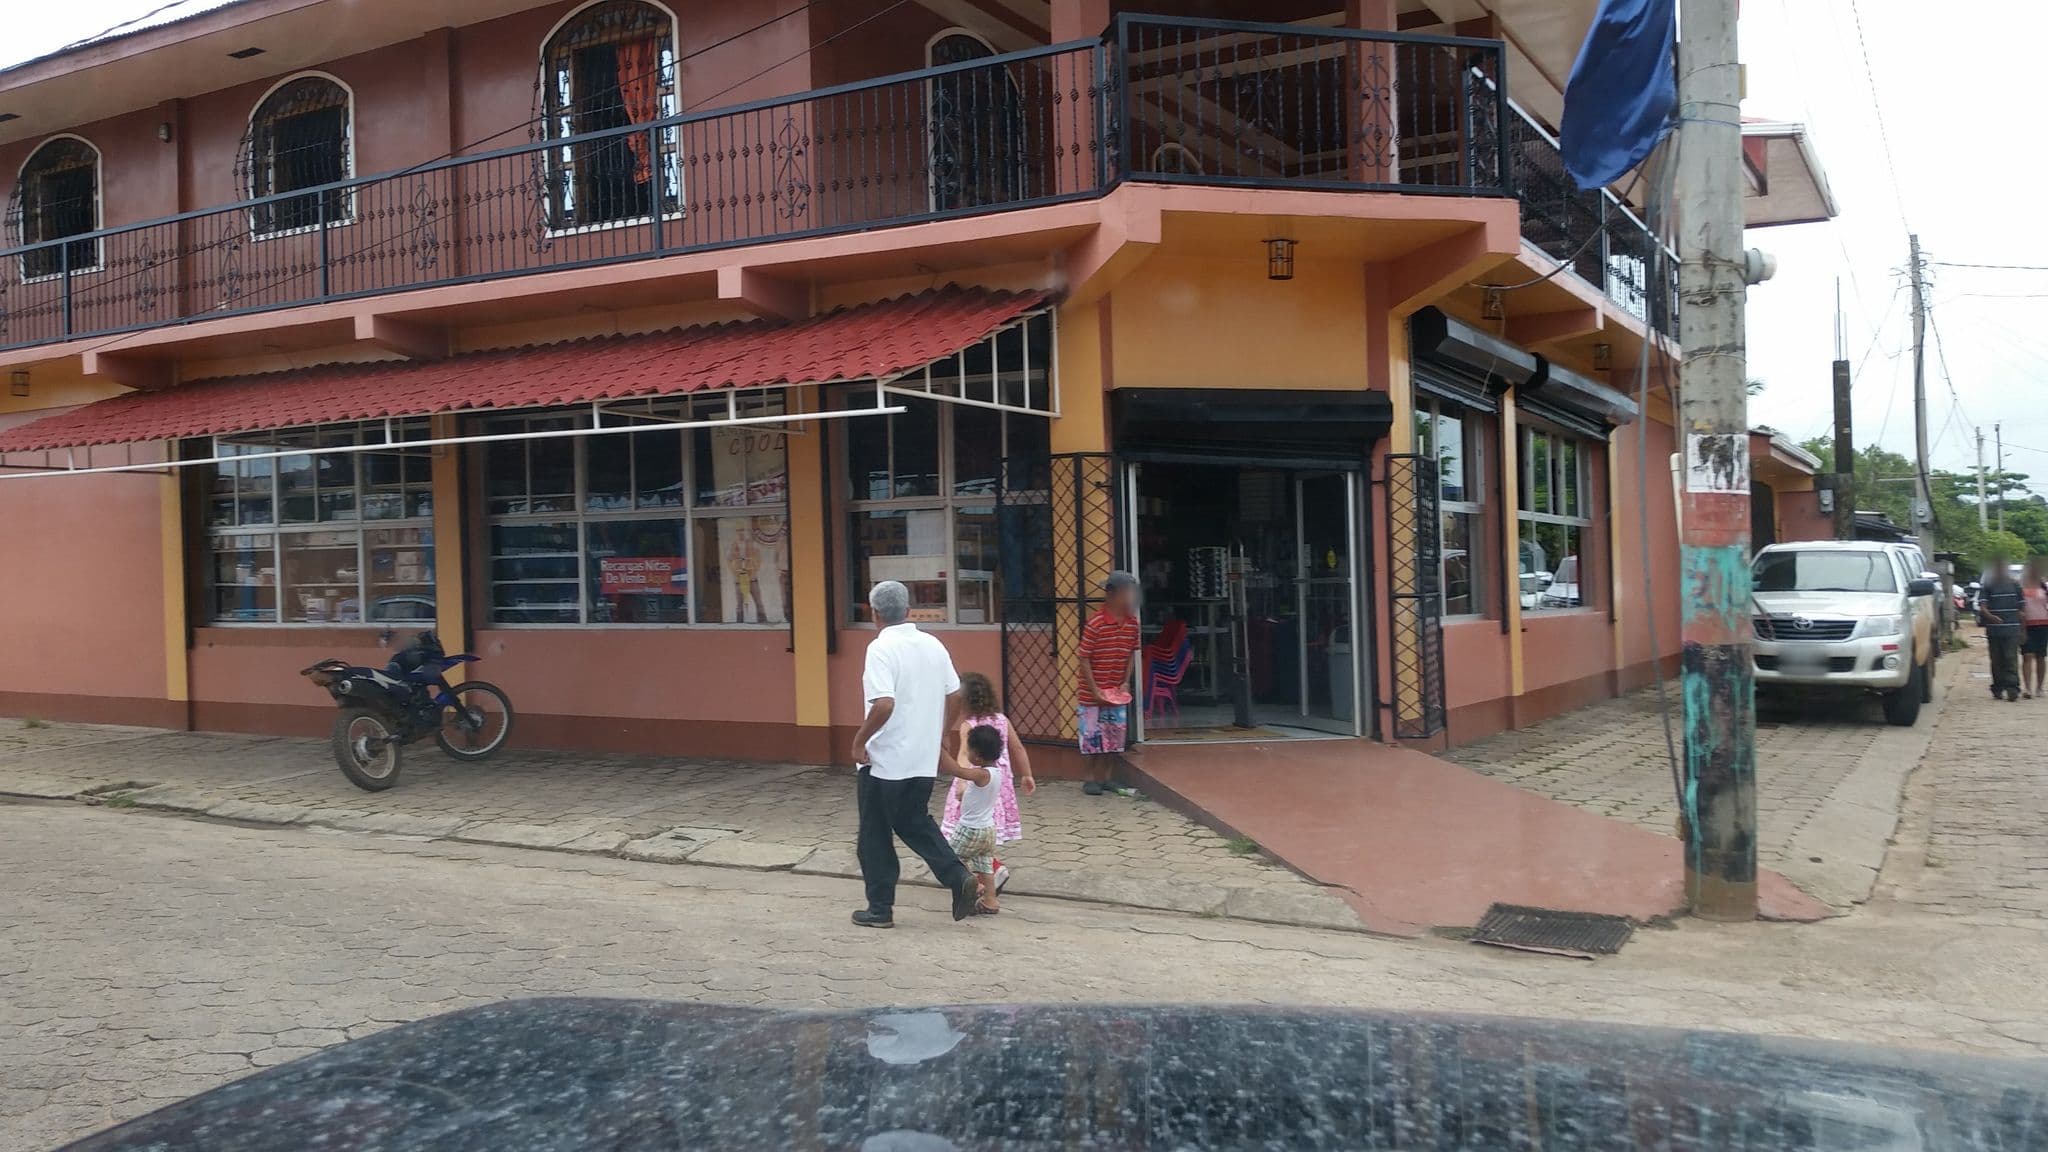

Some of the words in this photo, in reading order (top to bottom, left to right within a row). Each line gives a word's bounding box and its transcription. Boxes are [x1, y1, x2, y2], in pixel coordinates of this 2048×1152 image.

[600, 560, 644, 574] Recargas
[606, 572, 619, 584] De
[619, 572, 646, 584] Venta
